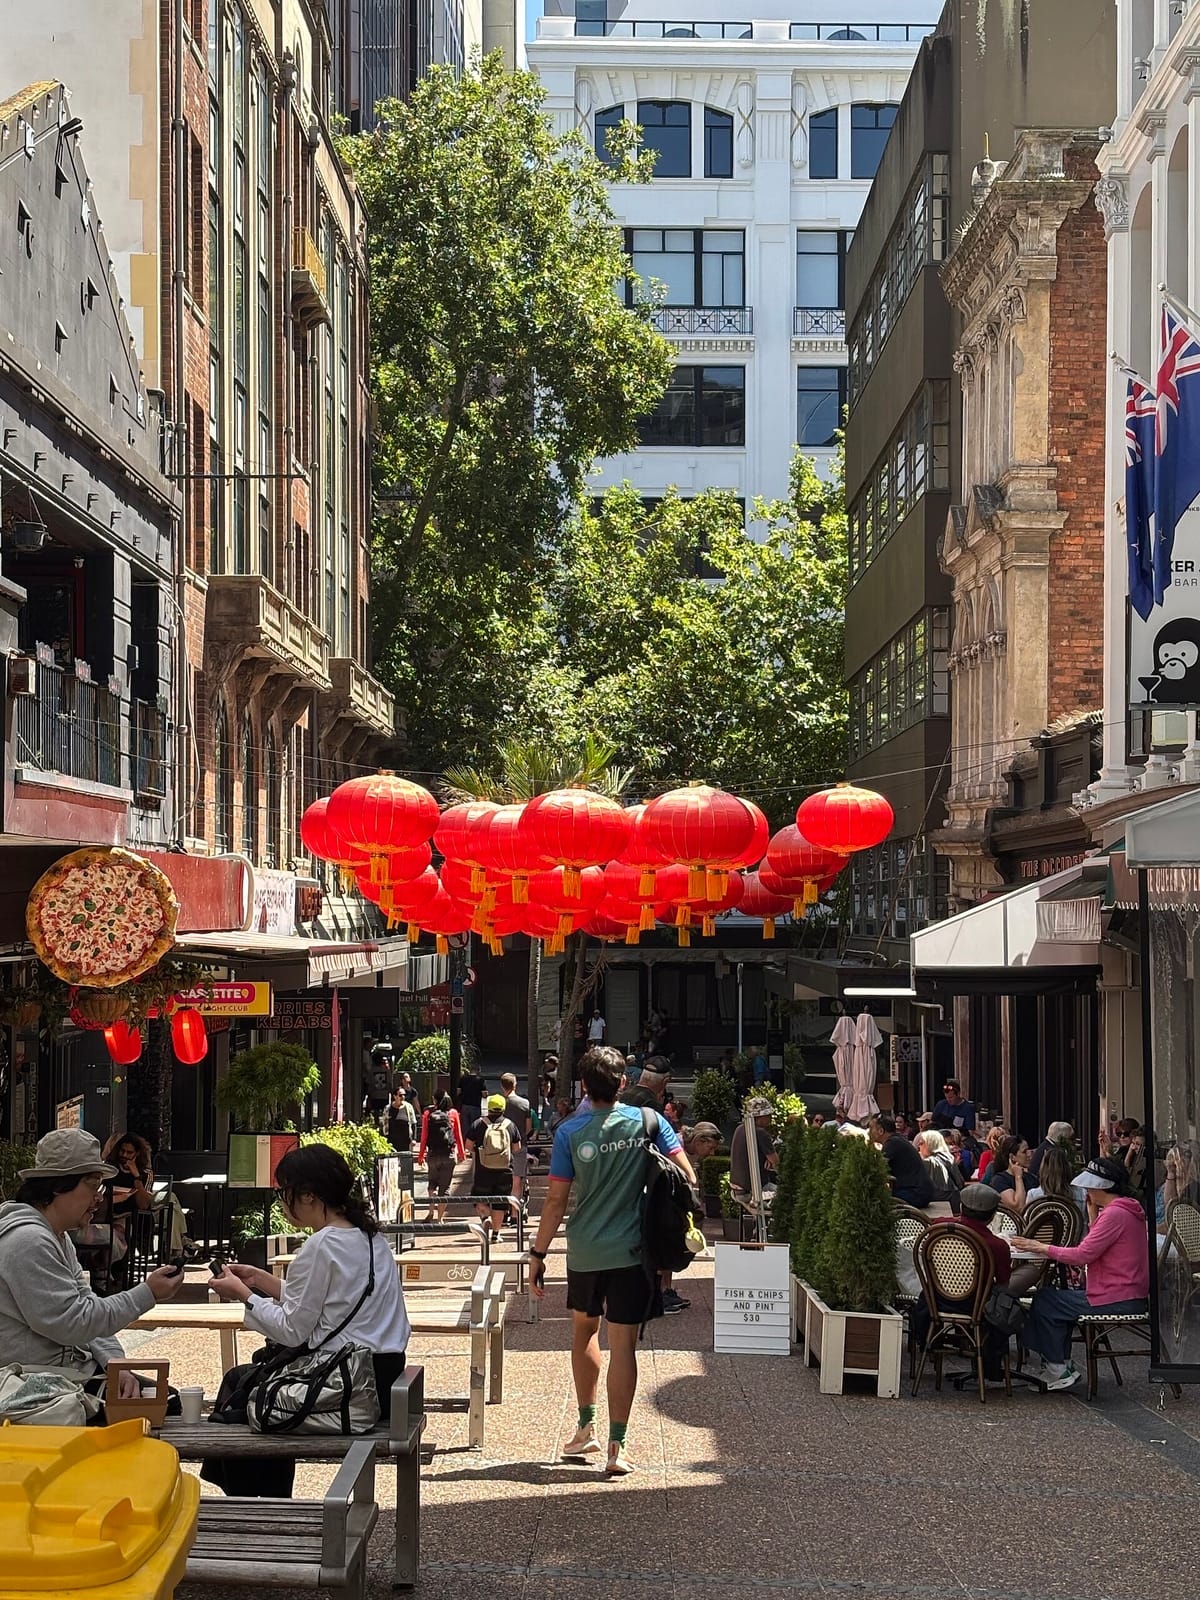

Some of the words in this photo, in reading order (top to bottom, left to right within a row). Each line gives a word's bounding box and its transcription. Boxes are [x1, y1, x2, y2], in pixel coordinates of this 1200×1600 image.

[1174, 578, 1198, 587] BAR
[1021, 860, 1039, 878] THE
[228, 1004, 248, 1012] CLUB
[273, 1001, 326, 1015] RRIES
[256, 1015, 332, 1029] KEBABS
[724, 1289, 745, 1299] FISH
[747, 1290, 754, 1299] &
[757, 1290, 784, 1300] CHIPS
[733, 1301, 751, 1310] AND
[755, 1302, 775, 1311] PINT
[743, 1313, 760, 1322] $30
